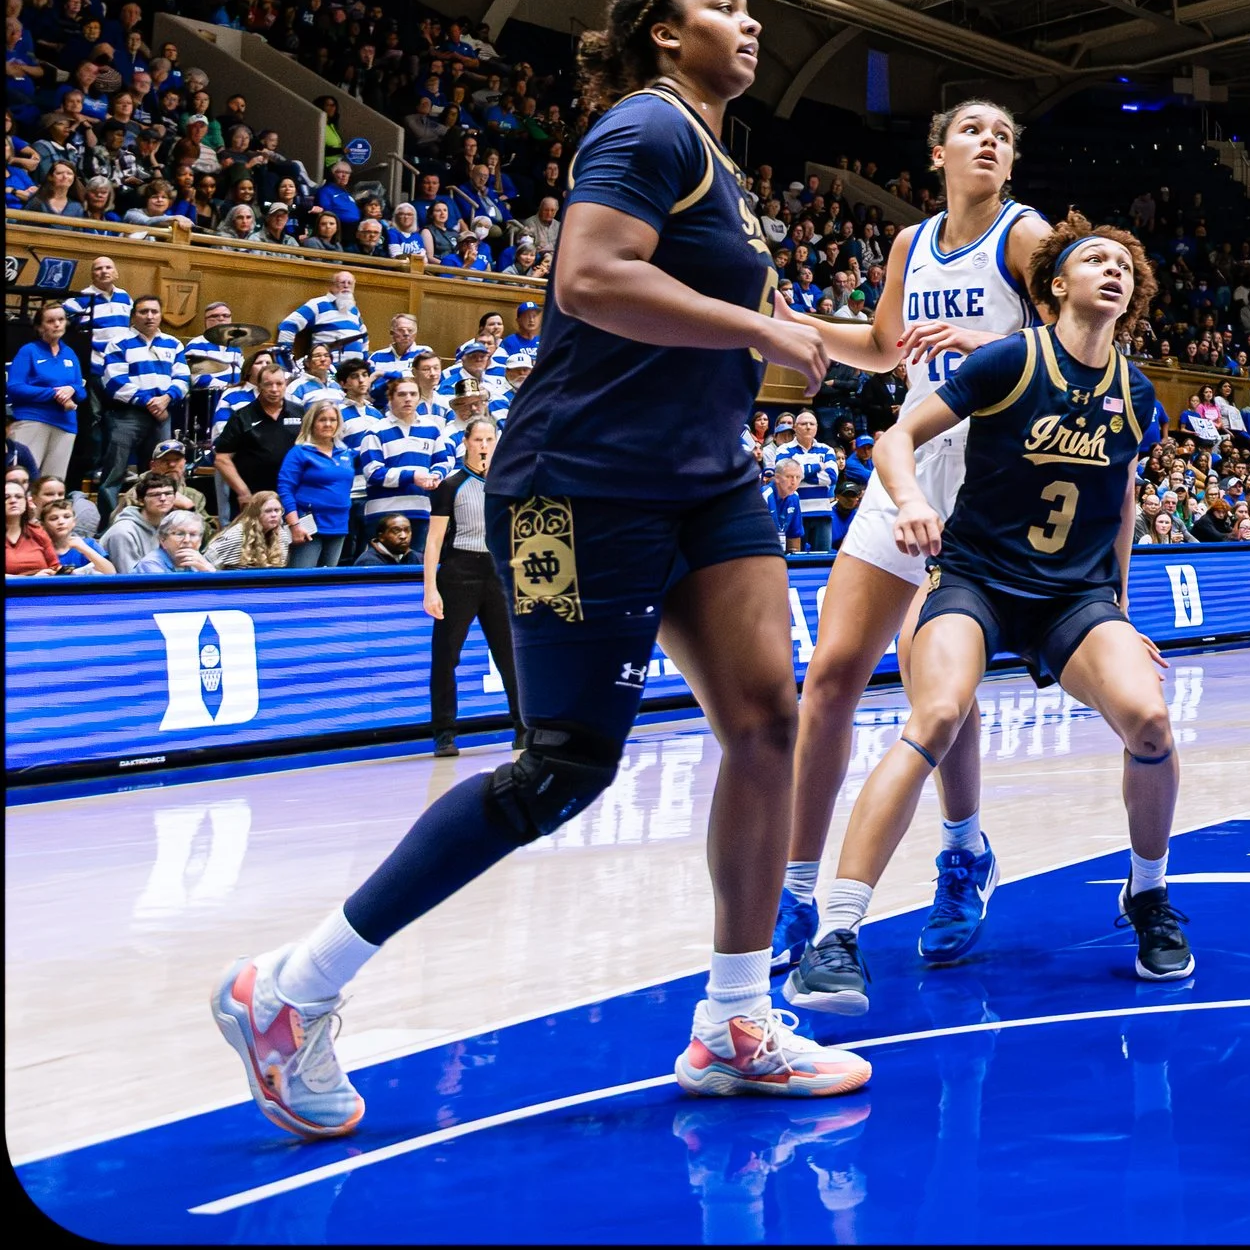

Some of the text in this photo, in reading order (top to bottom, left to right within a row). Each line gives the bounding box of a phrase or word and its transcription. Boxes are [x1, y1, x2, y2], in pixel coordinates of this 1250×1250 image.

[165, 285, 194, 315] 17
[909, 288, 984, 321] DUKE
[1024, 414, 1109, 461] Irish
[1028, 480, 1079, 554] 3
